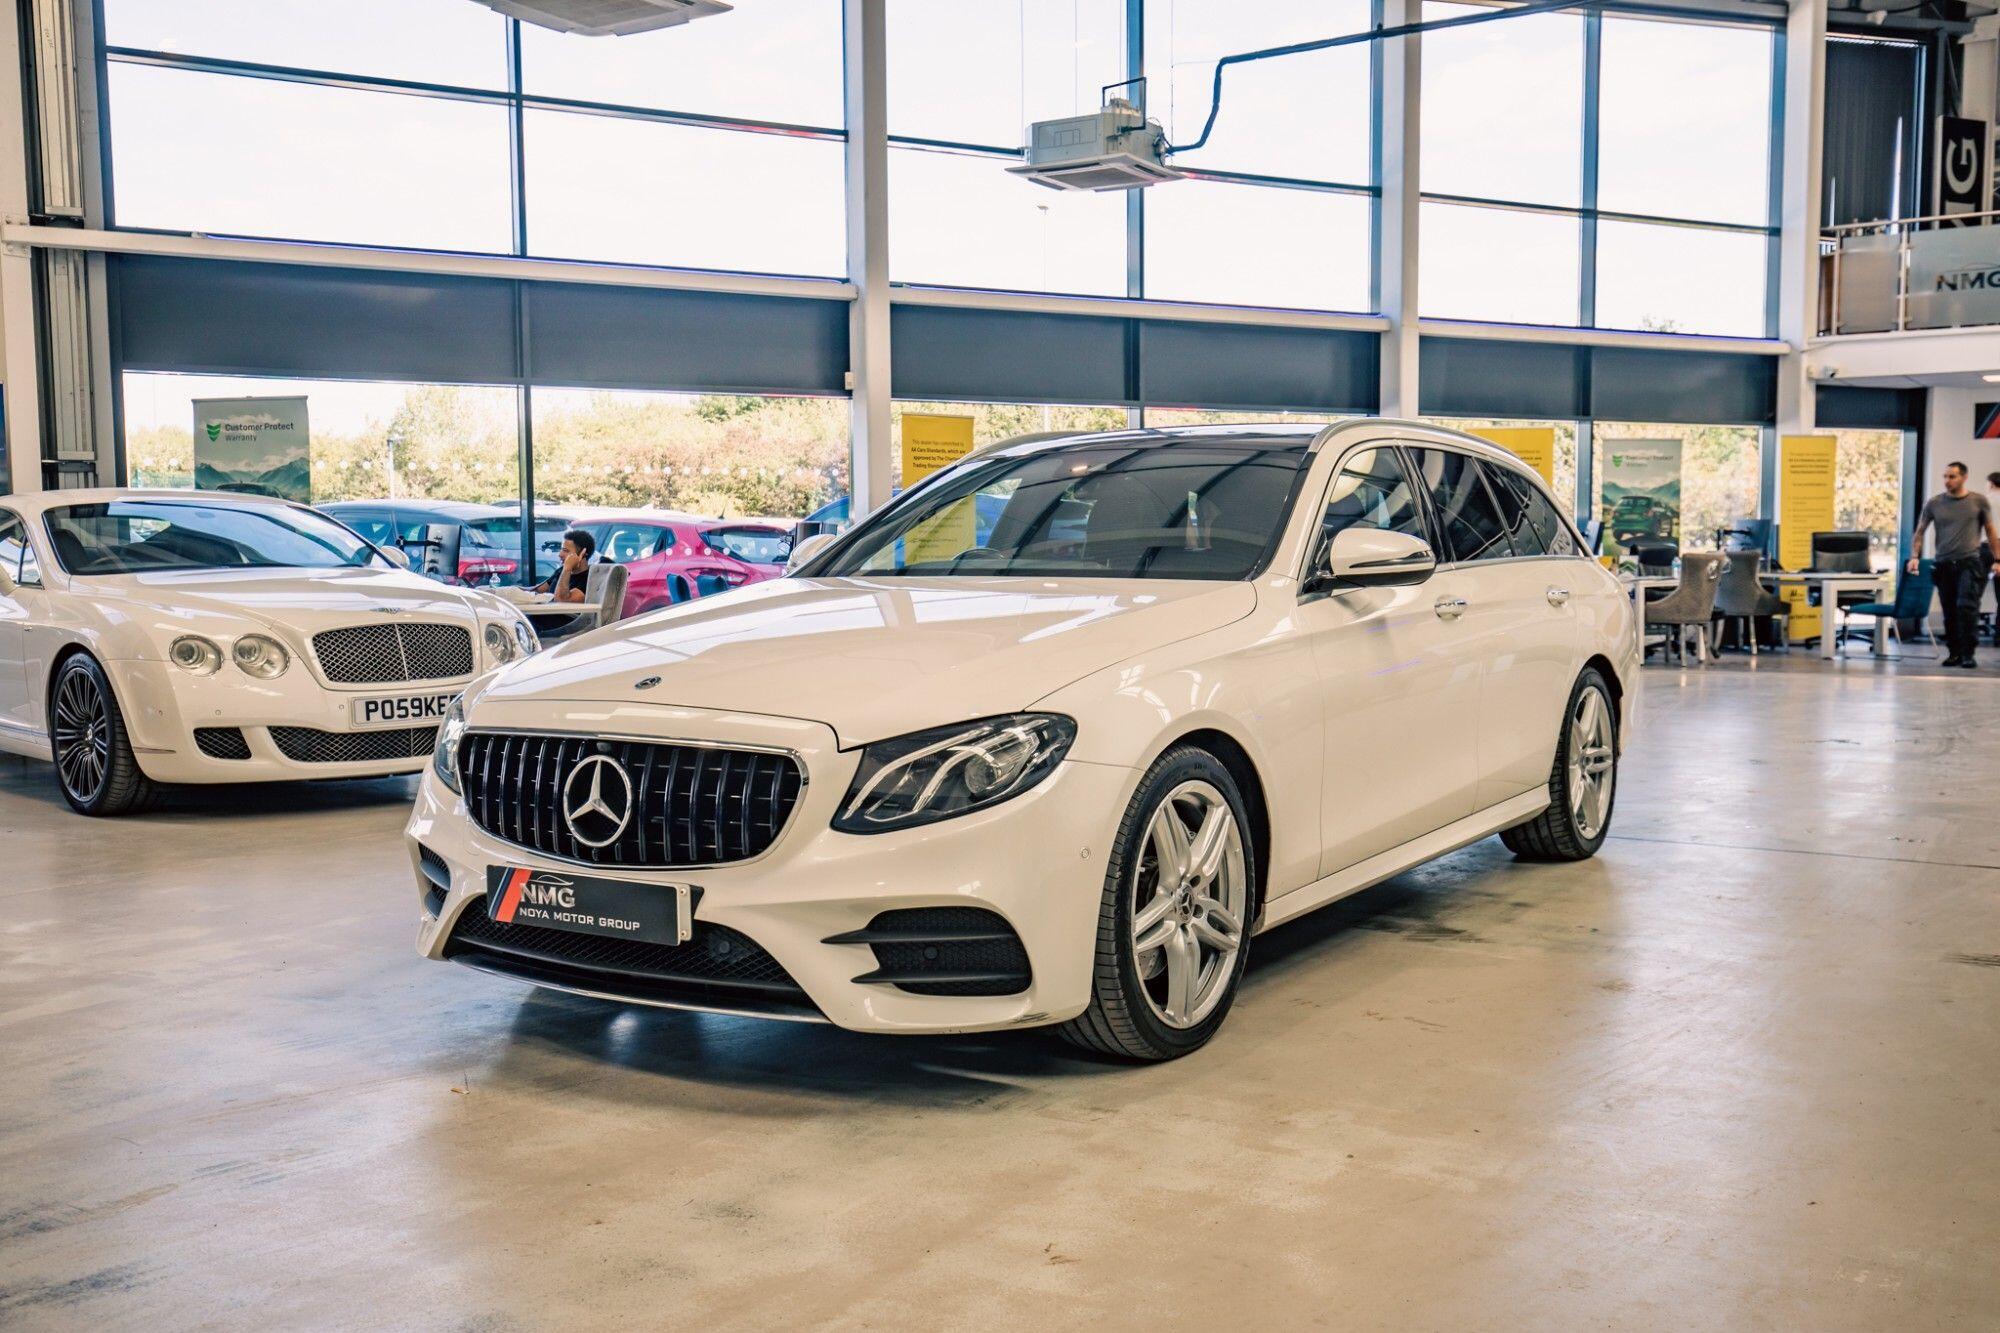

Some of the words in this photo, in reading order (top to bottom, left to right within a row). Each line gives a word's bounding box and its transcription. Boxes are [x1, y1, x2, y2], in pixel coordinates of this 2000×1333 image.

[264, 422, 294, 430] Protect
[365, 695, 461, 721] PO59KE
[520, 883, 576, 908] NMG
[519, 907, 550, 919] NOYA
[553, 912, 594, 925] MOTOR
[599, 918, 640, 931] GROUP
